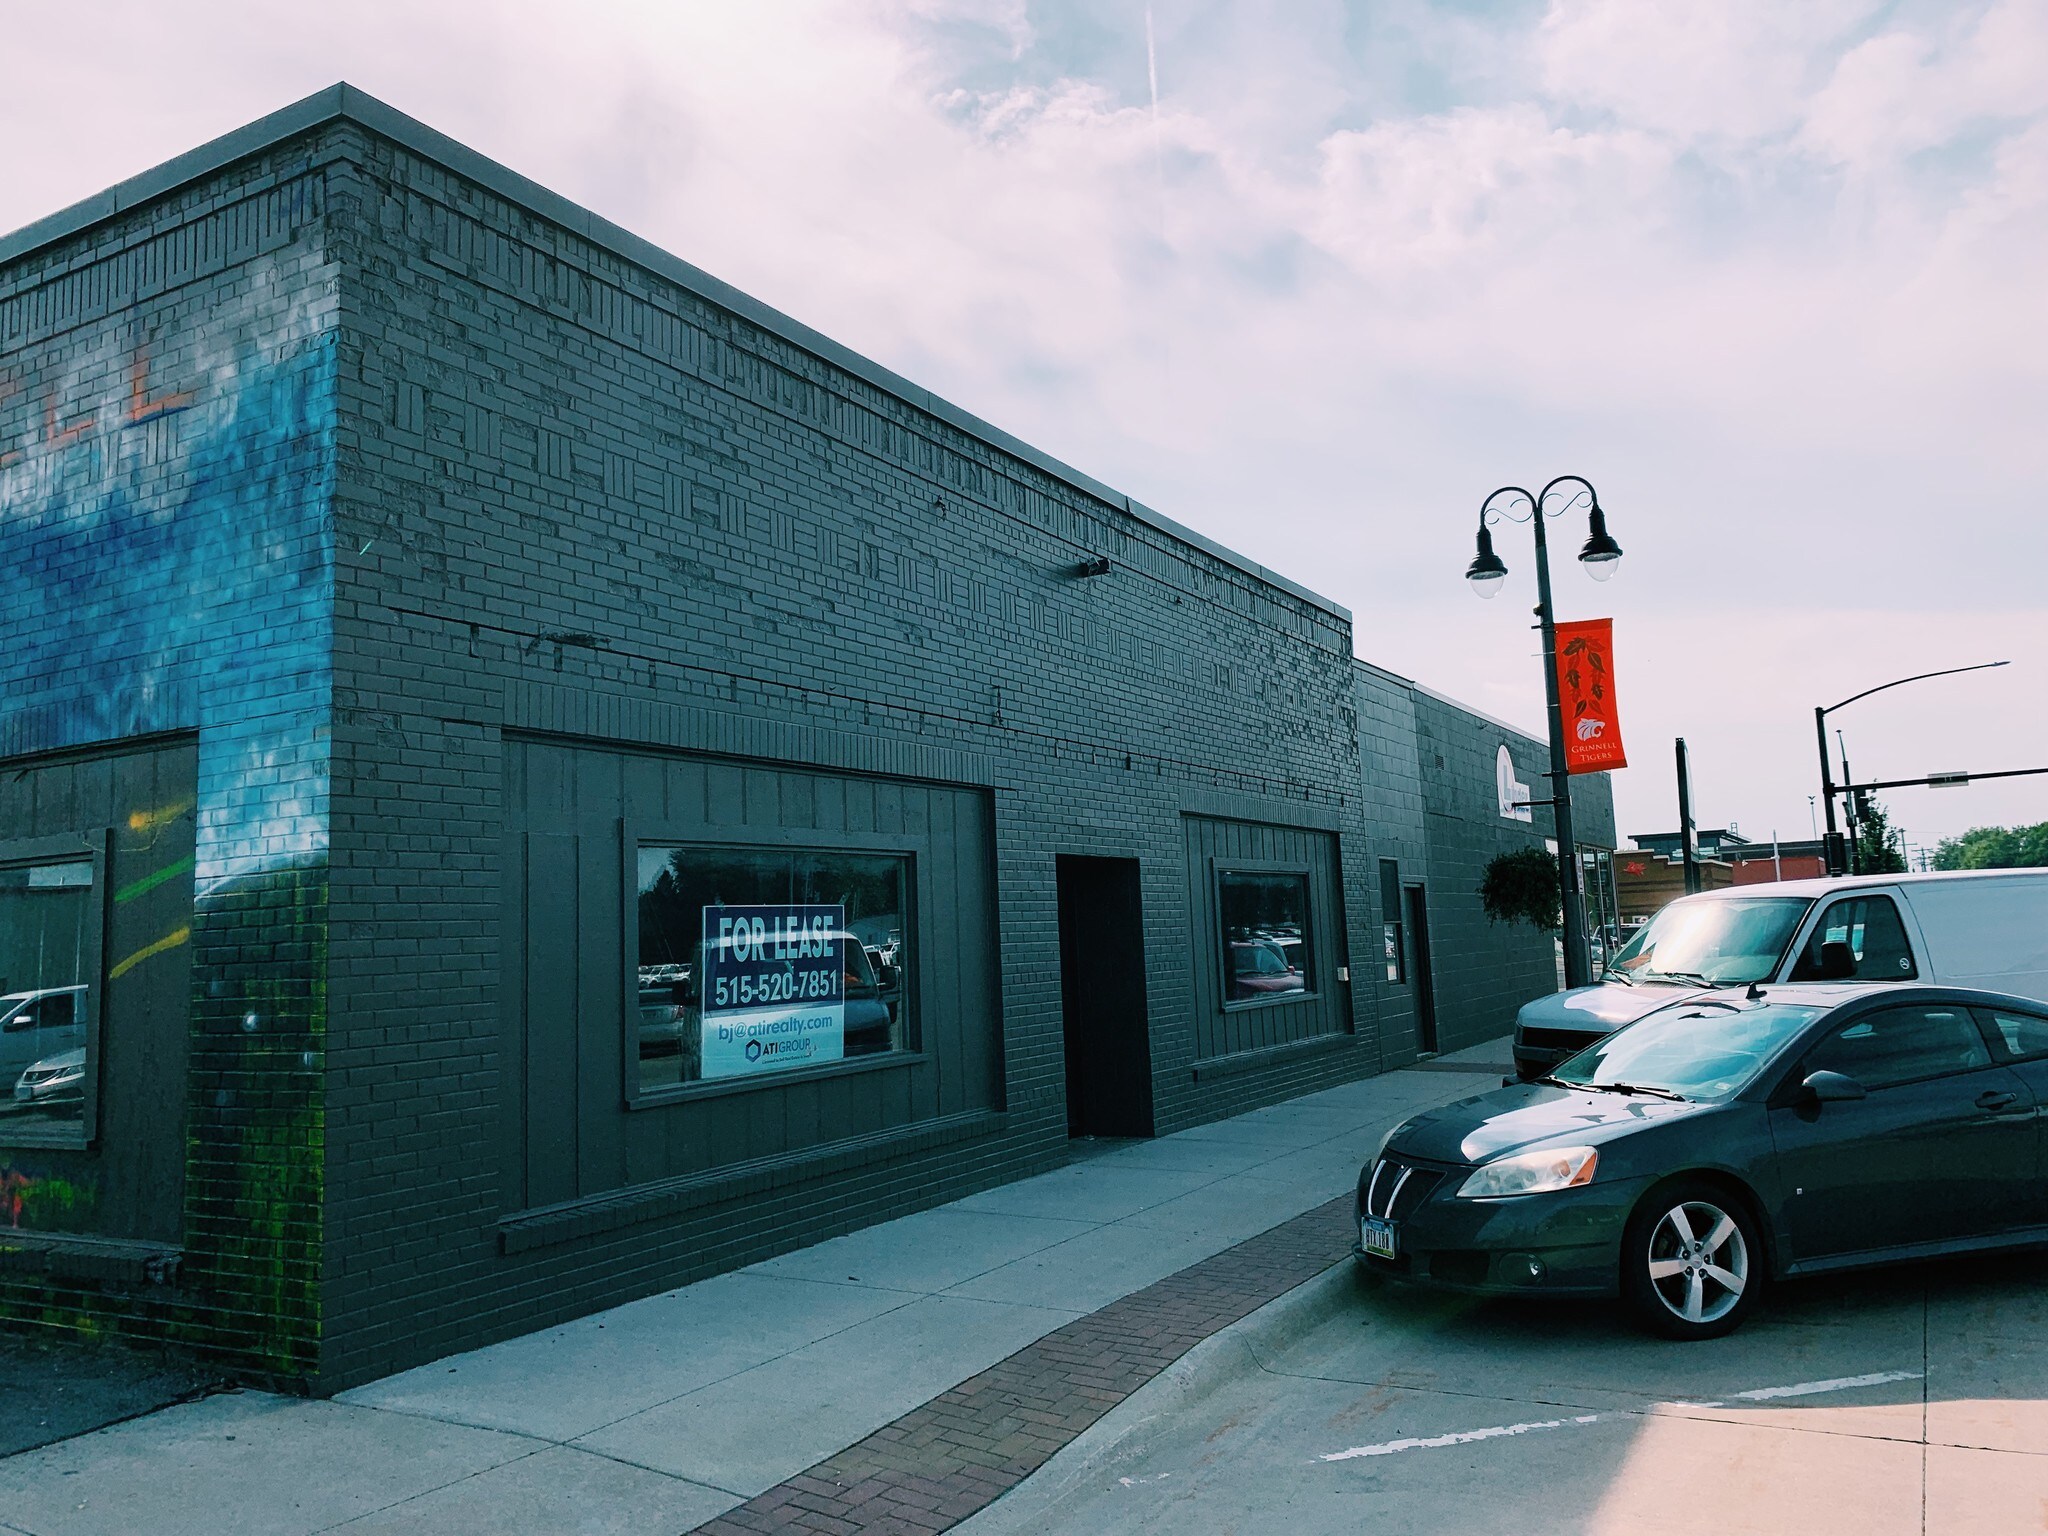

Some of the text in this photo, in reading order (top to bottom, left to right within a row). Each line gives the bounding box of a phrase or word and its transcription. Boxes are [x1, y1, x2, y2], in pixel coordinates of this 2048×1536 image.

[1580, 752, 1613, 762] TIGERS
[719, 915, 834, 963] FOR LEASE
[715, 969, 837, 1006] 515-520-7851
[718, 1016, 833, 1043] bj@atirealty.com
